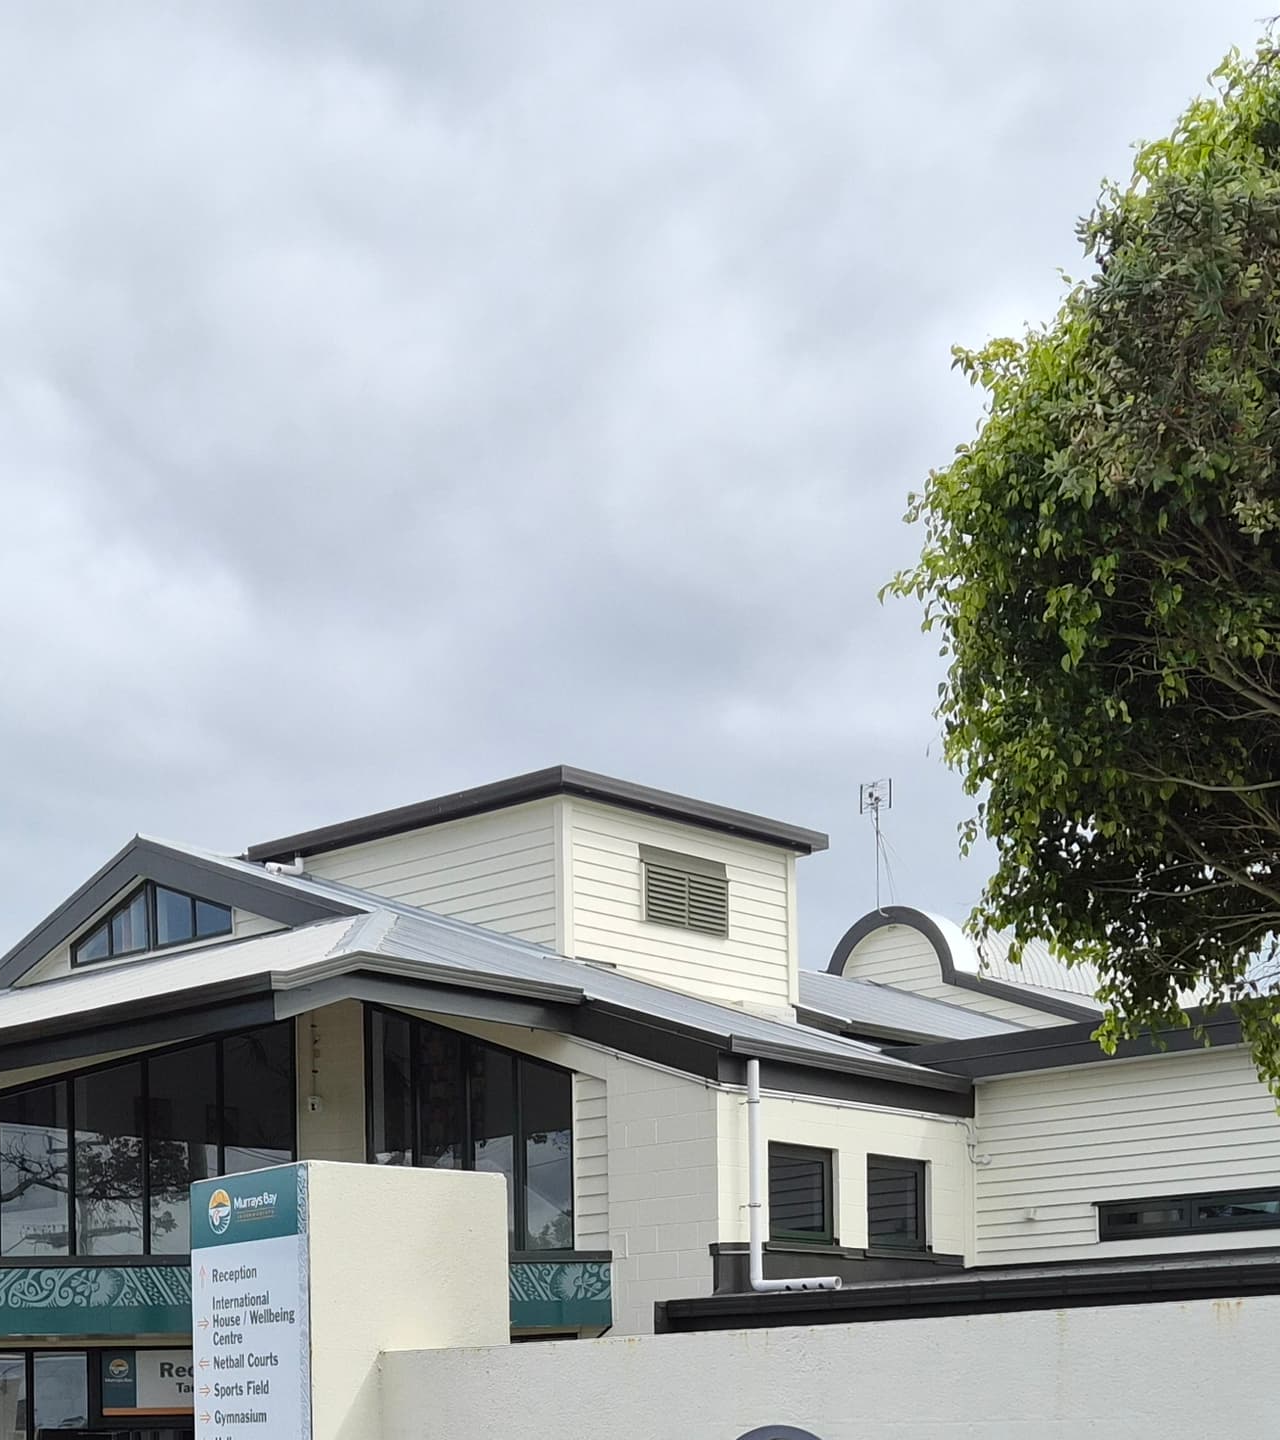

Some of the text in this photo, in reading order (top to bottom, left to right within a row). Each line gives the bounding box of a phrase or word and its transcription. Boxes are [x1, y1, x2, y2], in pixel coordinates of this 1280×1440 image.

[233, 1191, 278, 1210] Murrays Bay
[212, 1265, 257, 1283] Reception
[212, 1290, 270, 1311] International
[212, 1306, 295, 1328] House / Wellbeing
[213, 1331, 243, 1346] Centre
[159, 1361, 194, 1378] Rec
[213, 1352, 279, 1370] Netball Courts
[214, 1379, 270, 1399] Sports Field
[214, 1408, 267, 1427] Gymnasium
